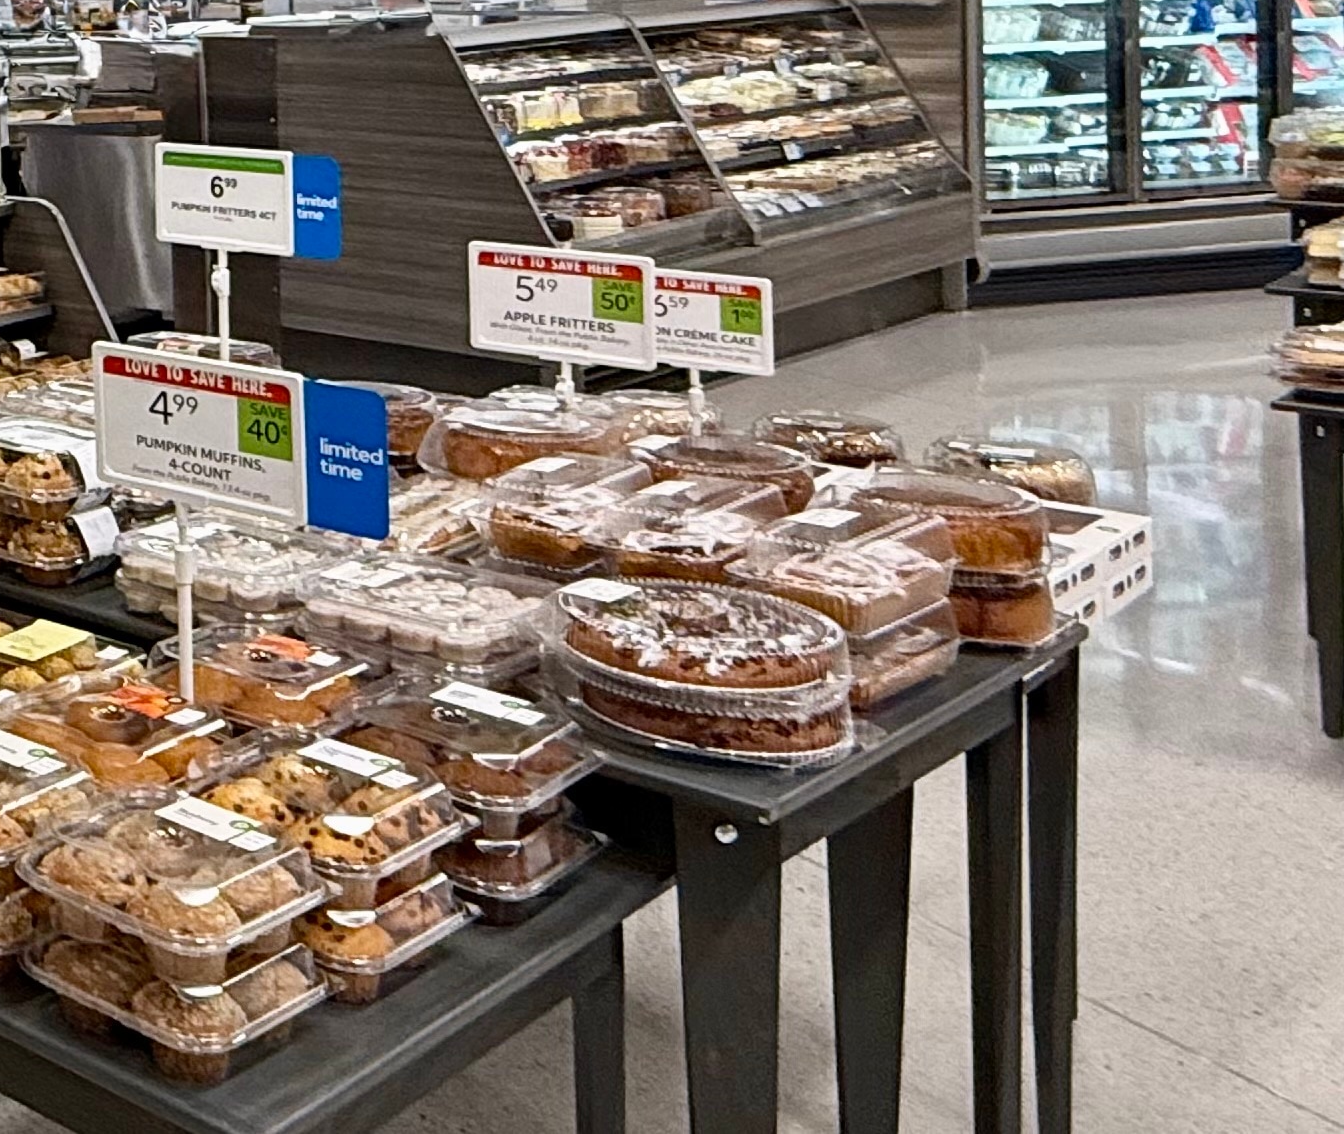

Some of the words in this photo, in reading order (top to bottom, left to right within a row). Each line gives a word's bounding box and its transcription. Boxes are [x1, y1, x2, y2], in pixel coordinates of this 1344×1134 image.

[296, 193, 338, 210] limited
[212, 206, 257, 220] FRITTERS
[296, 208, 325, 222] time
[551, 257, 581, 273] SAVE
[602, 281, 634, 294] SAVE
[503, 309, 547, 327] APPLE
[549, 316, 617, 334] FRITTERS
[720, 334, 757, 346] CAKE
[124, 357, 160, 379] LOVE
[165, 366, 184, 382] TO
[190, 368, 226, 390] SAVE
[231, 375, 273, 398] HERE.
[249, 402, 288, 421] SAVE
[136, 434, 198, 459] PUMPKIN
[319, 436, 384, 466] limited
[168, 457, 232, 481] 4-COUNT
[320, 457, 364, 482] time
